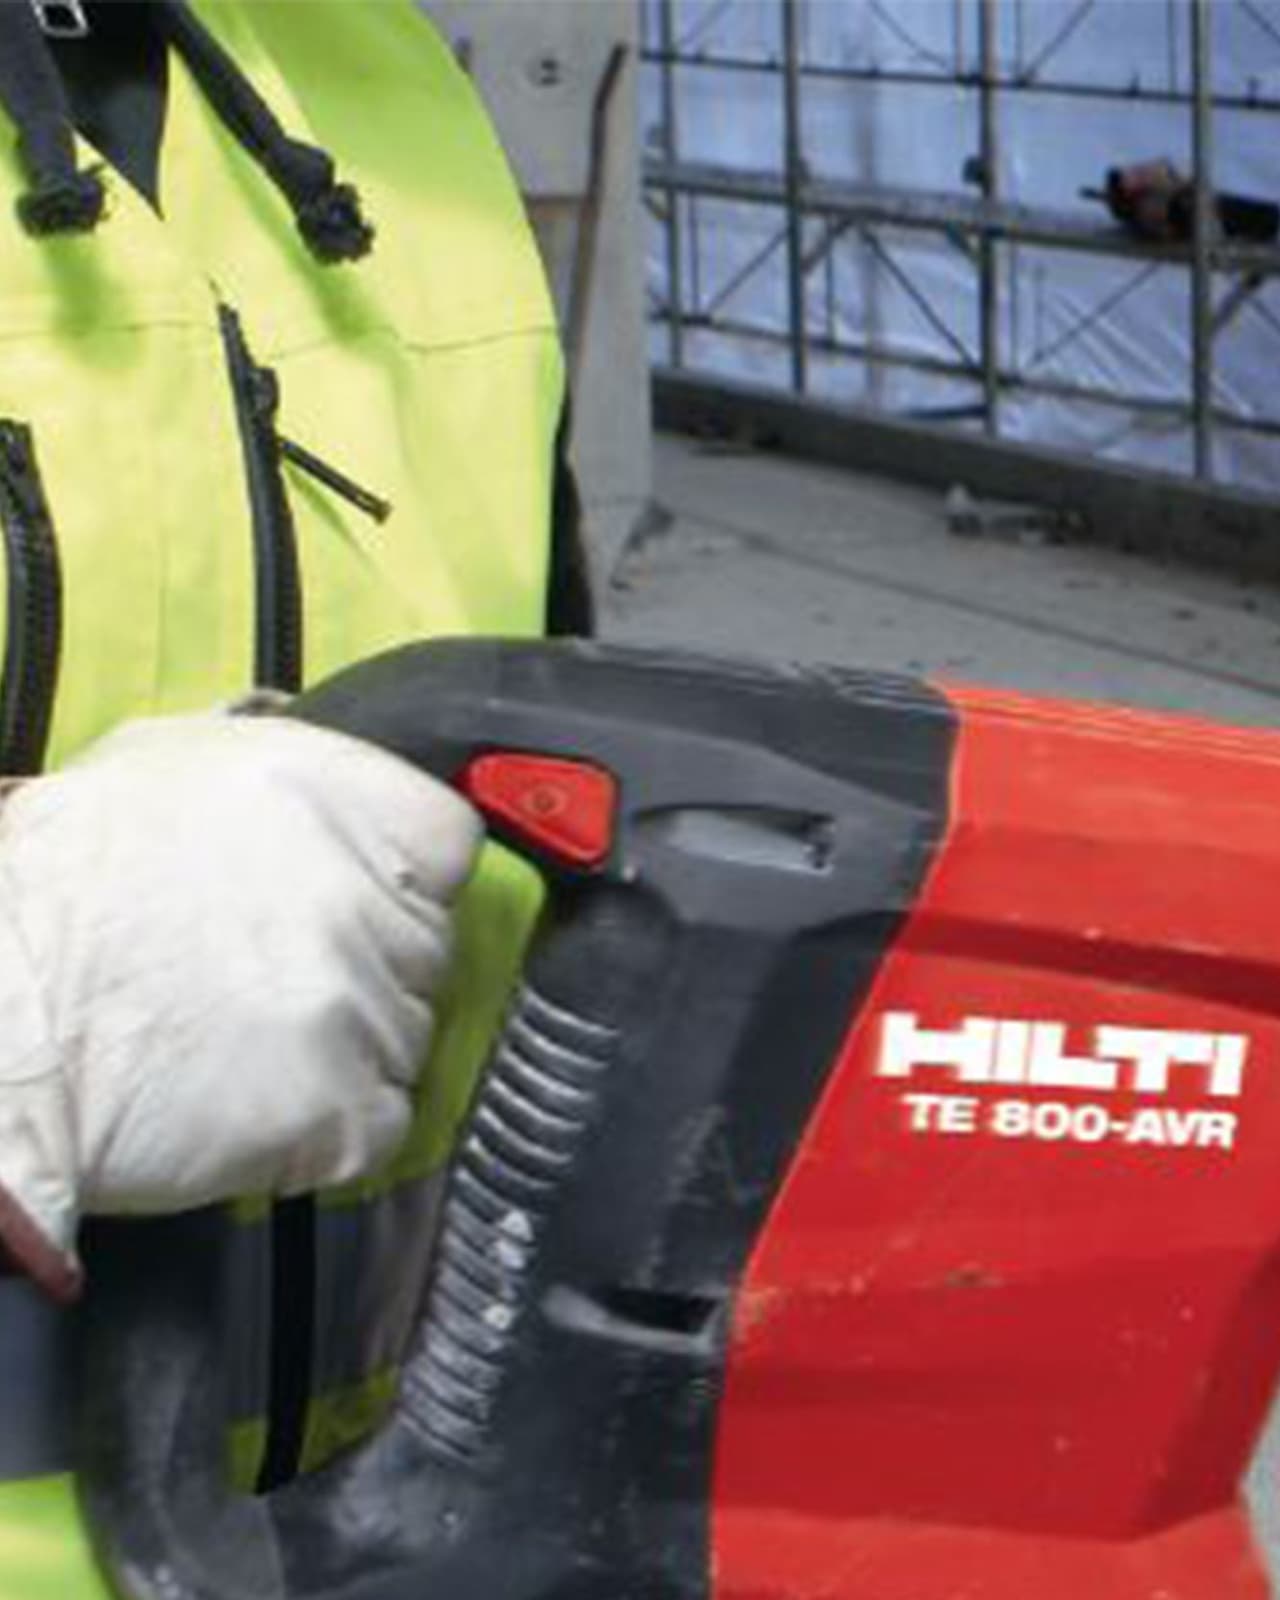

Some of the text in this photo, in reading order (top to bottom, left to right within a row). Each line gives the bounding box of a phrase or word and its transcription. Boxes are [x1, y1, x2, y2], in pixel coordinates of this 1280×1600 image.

[876, 1011, 1249, 1096] HILTI
[903, 1093, 1238, 1149] TE 800-AVR
